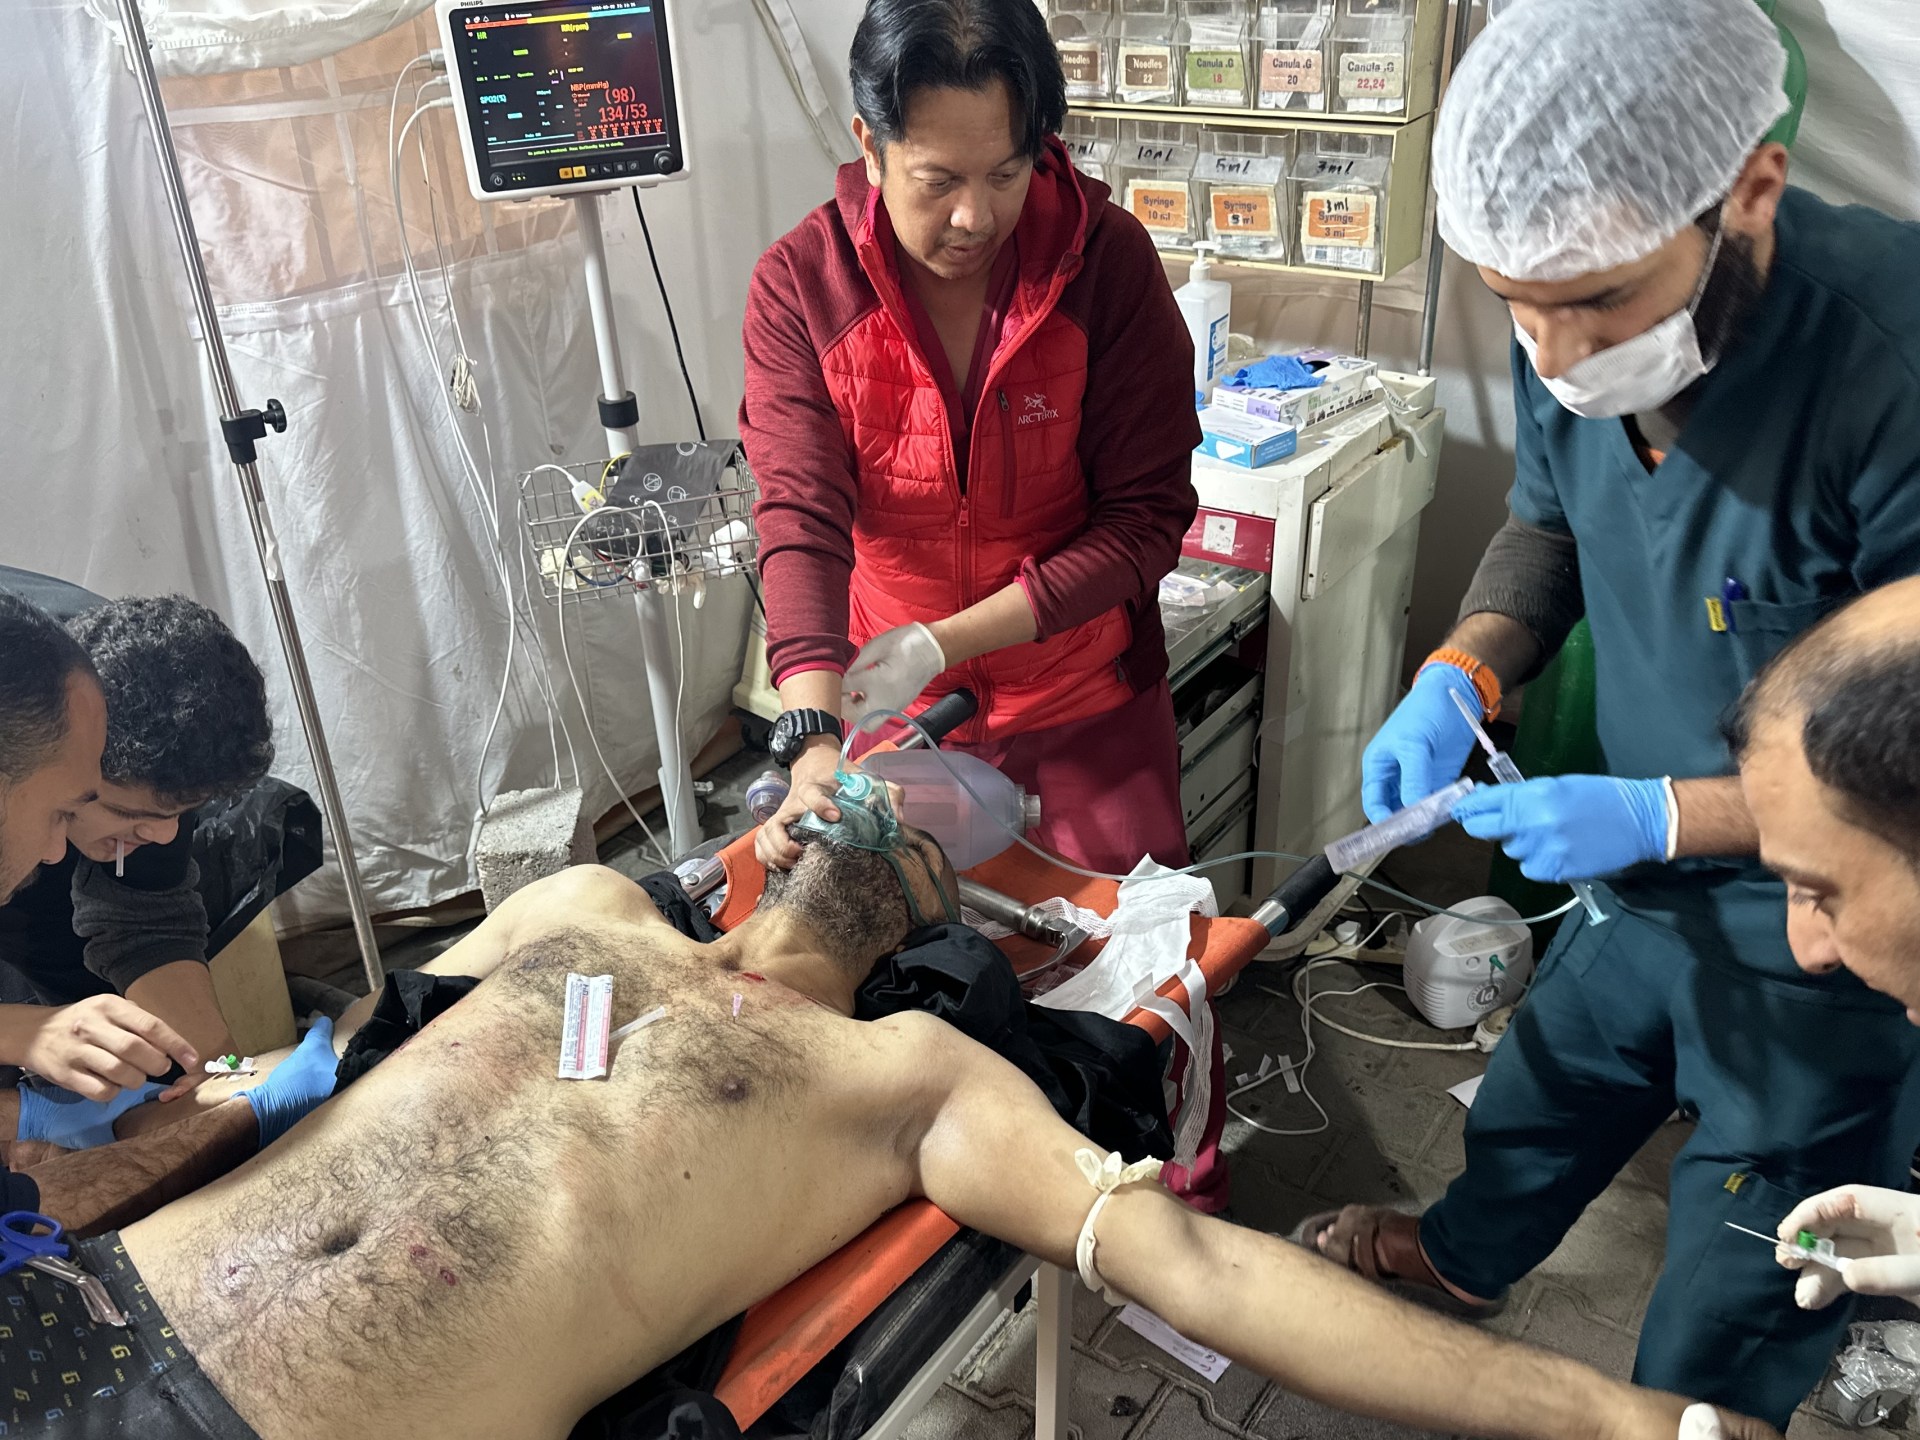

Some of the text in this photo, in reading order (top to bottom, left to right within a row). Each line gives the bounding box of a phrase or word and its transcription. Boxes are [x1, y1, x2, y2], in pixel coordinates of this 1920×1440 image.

[1063, 54, 1090, 65] Needles
[1132, 58, 1163, 69] Needles
[1196, 58, 1223, 68] Canula
[1272, 58, 1301, 69] Canula
[1347, 61, 1380, 72] Canula
[1073, 69, 1082, 79] 18
[1213, 73, 1223, 83] 18
[570, 80, 609, 91] NBP(mmHg)
[1287, 75, 1298, 85] 20
[1357, 78, 1385, 91] 22,24
[605, 86, 636, 104] (98)
[599, 103, 648, 122] 134/53
[1143, 195, 1175, 207] Syringe
[1223, 200, 1257, 213] Syringe
[1318, 211, 1354, 224] Syringe
